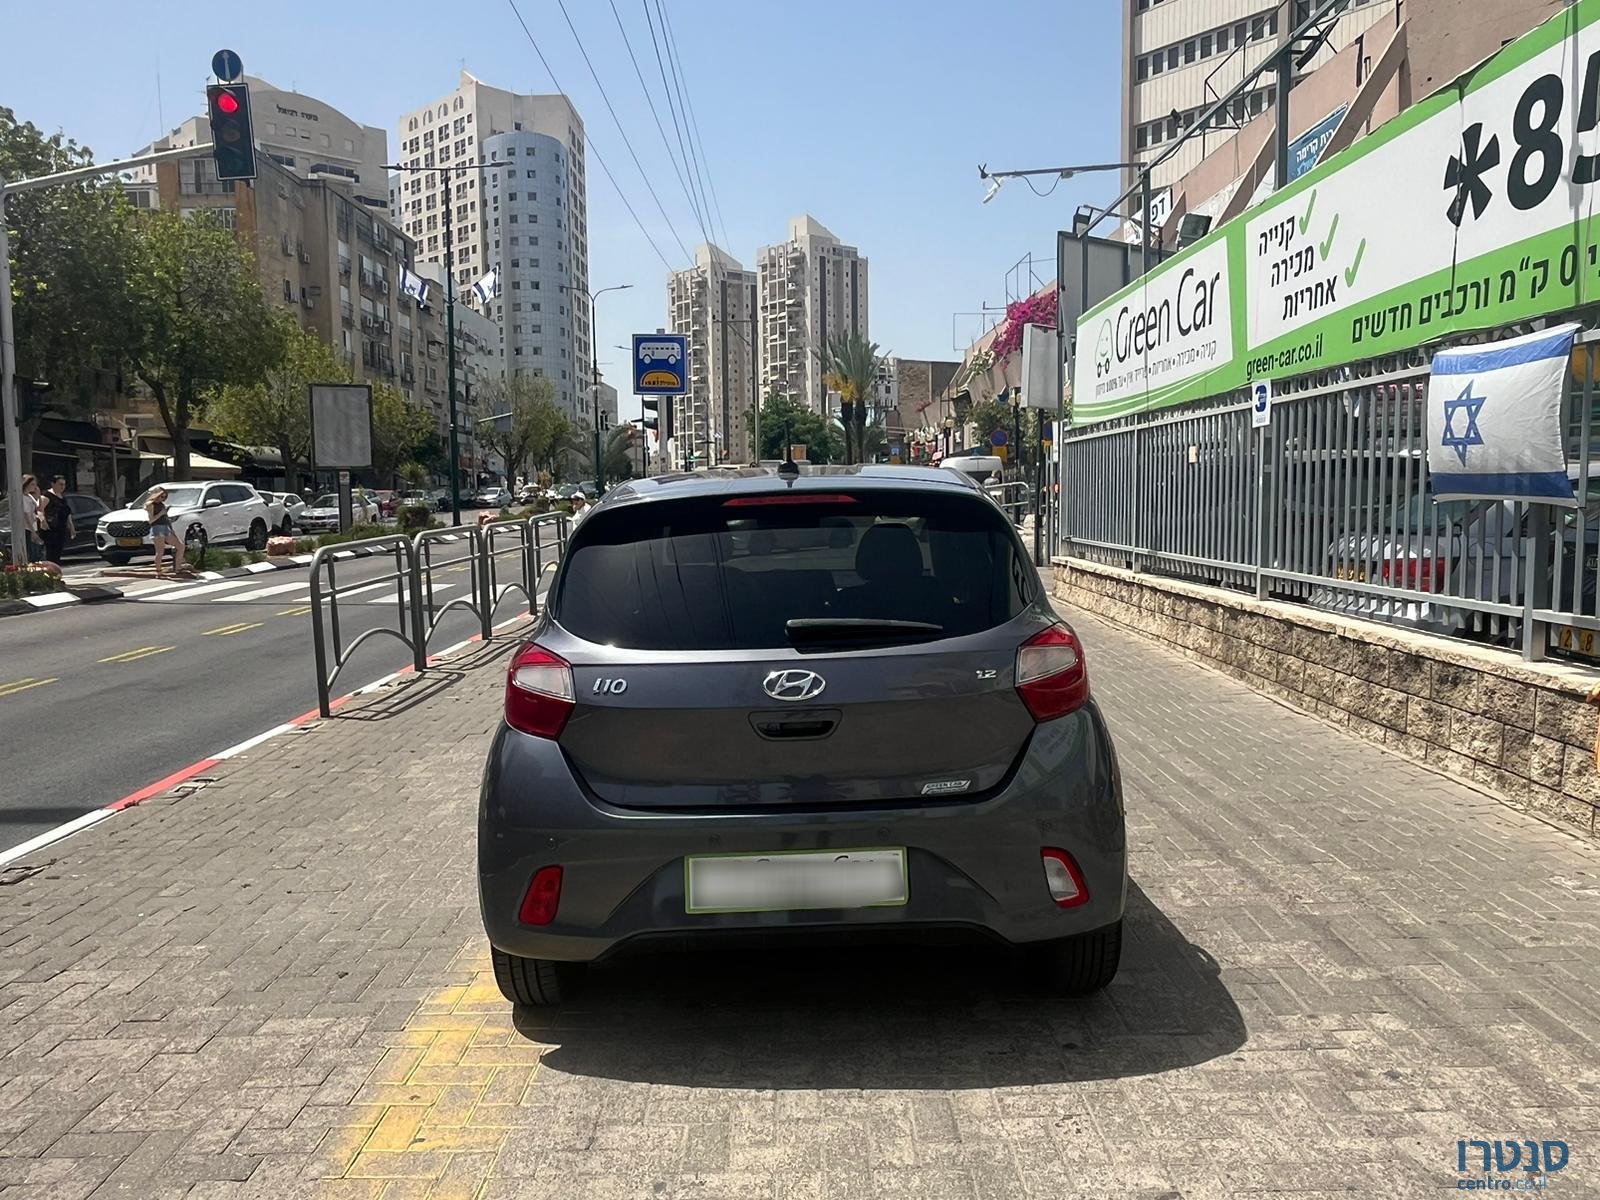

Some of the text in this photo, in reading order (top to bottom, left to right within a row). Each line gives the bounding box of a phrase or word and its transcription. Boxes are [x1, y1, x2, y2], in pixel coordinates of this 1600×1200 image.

[1258, 215, 1295, 256] קנייה
[1271, 245, 1315, 287] מכירה
[1116, 267, 1220, 363] Green Car
[1282, 275, 1337, 320] אחריות
[1419, 277, 1490, 325] ורכבים
[1352, 302, 1412, 344] חדשים
[1247, 333, 1323, 381] green-car.co.il
